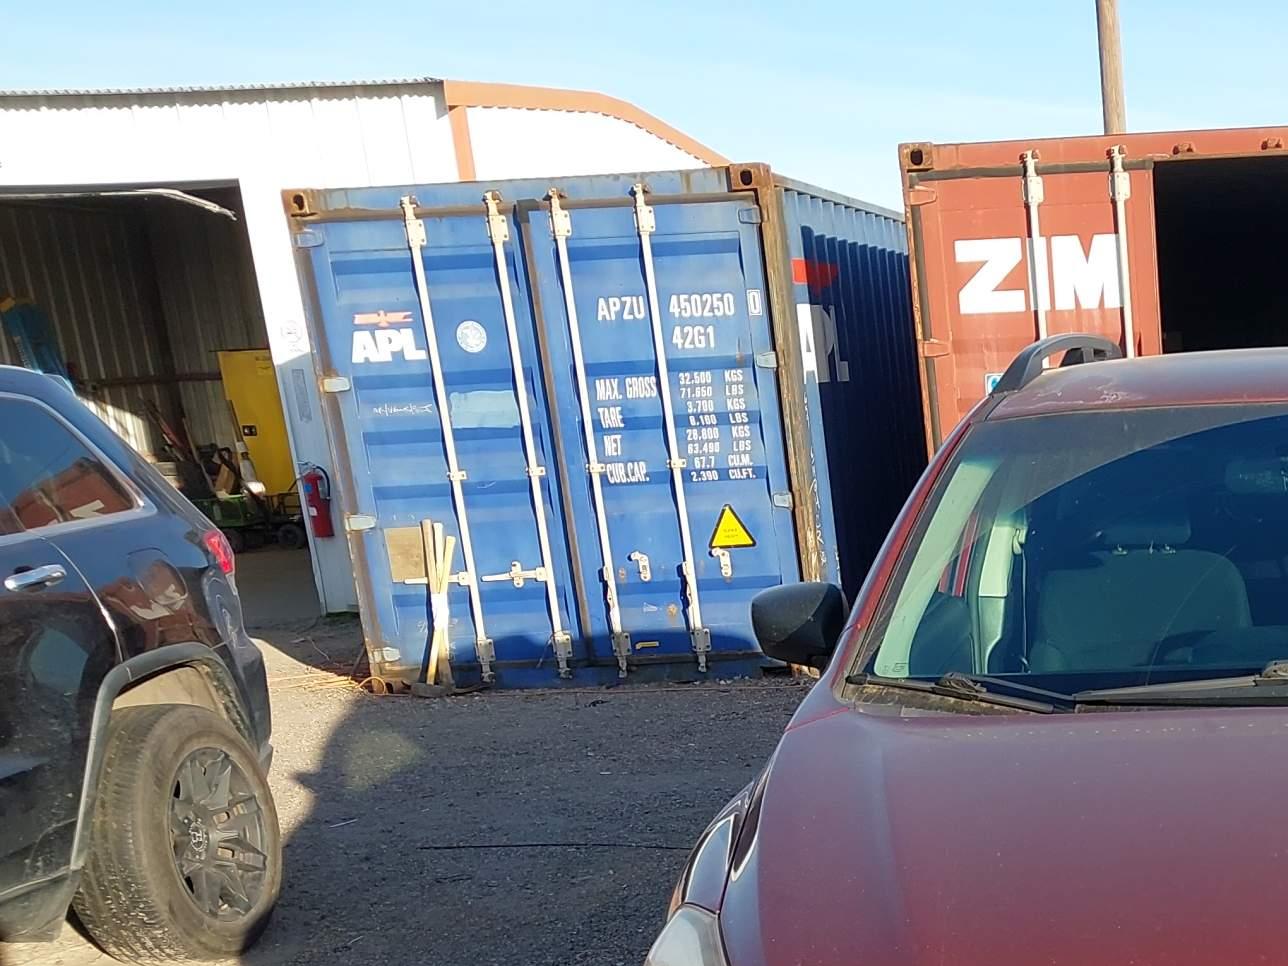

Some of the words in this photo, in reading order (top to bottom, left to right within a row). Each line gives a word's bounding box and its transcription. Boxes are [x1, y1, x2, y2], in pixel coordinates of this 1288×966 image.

[954, 233, 1125, 315] ZIM
[597, 295, 646, 321] APZU
[669, 292, 735, 318] 450250
[351, 328, 428, 363] APL
[672, 325, 715, 350] 42G1
[796, 304, 850, 385] APL
[724, 370, 743, 382] KGS
[595, 379, 623, 401] MAX.
[625, 376, 657, 399] GROSS
[725, 384, 744, 396] LBS
[727, 398, 746, 411] KGS
[597, 407, 625, 429] TARE
[729, 413, 749, 424] LBS
[732, 426, 751, 438] KGS
[603, 435, 623, 457] NET
[733, 440, 752, 452] LBS
[694, 456, 715, 469] 67.7
